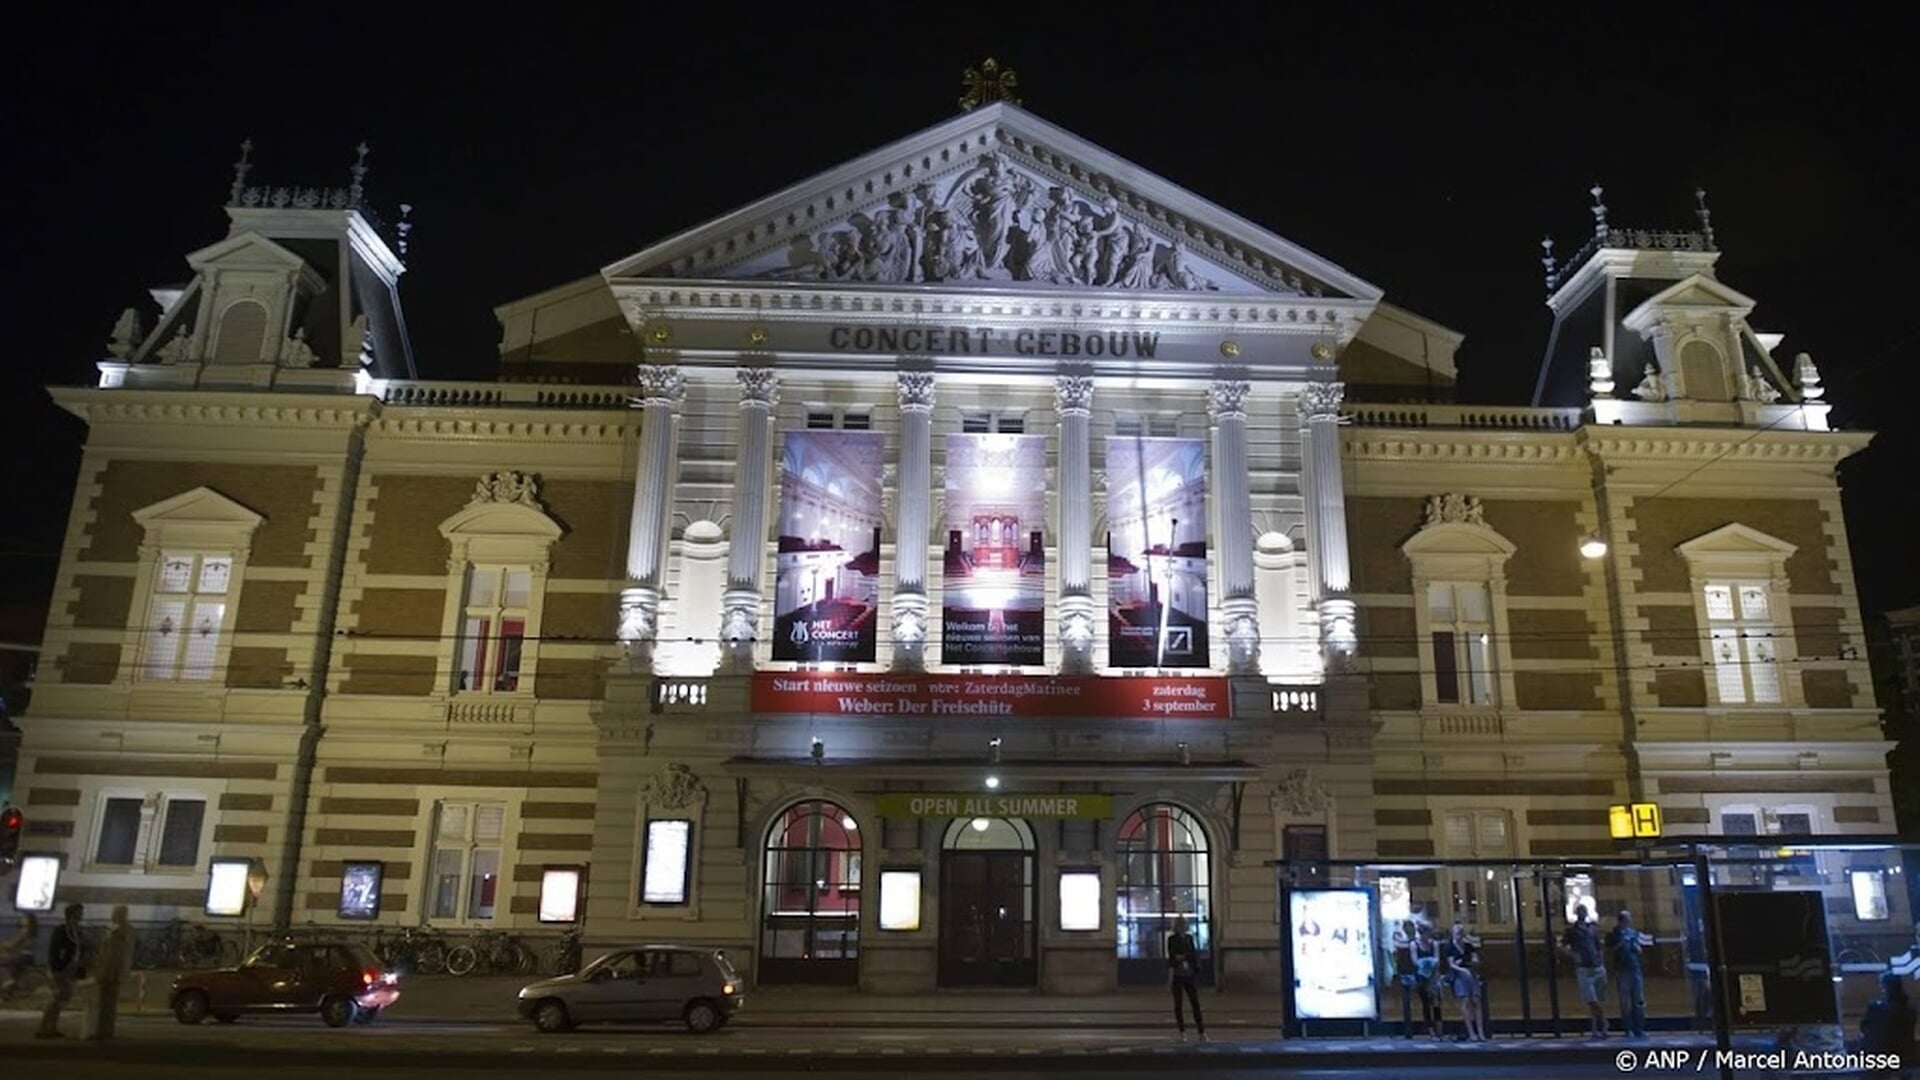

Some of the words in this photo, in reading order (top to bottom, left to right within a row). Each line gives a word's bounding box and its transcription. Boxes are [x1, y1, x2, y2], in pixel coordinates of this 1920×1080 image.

[829, 327, 993, 353] CONCERT
[1015, 328, 1160, 358] GEBOUW
[811, 620, 832, 629] HET
[945, 622, 986, 631] Welkom
[811, 630, 859, 640] CONCERT
[773, 678, 809, 692] Start
[814, 679, 863, 693] nieuwe
[867, 680, 917, 693] seizoen
[965, 681, 1081, 697] ZaterdagMatinee
[1153, 684, 1207, 698] zaterdag
[838, 698, 894, 713] Weber:
[899, 698, 927, 713] Der
[932, 699, 1014, 715] Freischütz
[1143, 699, 1151, 711] 3
[1153, 700, 1217, 714] september
[911, 798, 957, 815] OPEN
[964, 798, 993, 815] ALL
[1000, 798, 1078, 816] SUMMER
[1636, 808, 1656, 832] H
